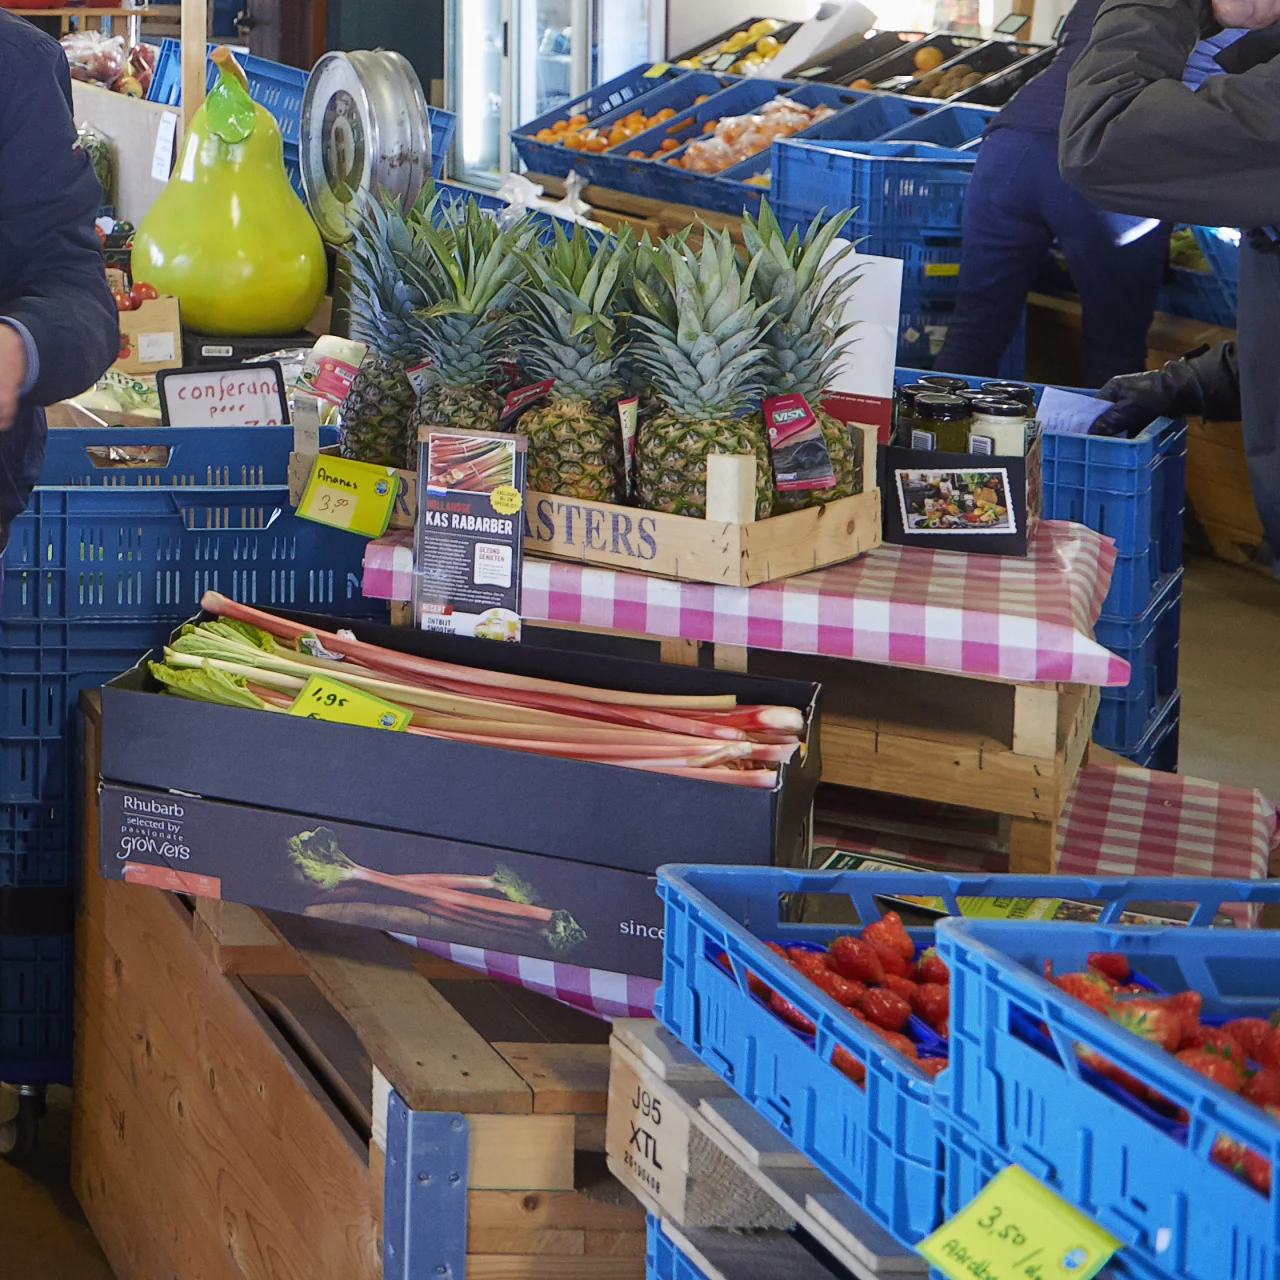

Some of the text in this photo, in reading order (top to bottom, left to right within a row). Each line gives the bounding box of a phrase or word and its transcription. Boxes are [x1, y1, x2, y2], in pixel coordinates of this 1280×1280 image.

[773, 407, 807, 422] VISA
[317, 467, 358, 490] Ananas
[425, 512, 513, 536] KAS RABARBER
[123, 795, 184, 818] Rhubarb
[121, 825, 184, 842] passionate
[126, 816, 181, 834] selected by
[116, 836, 191, 860] growers
[619, 920, 666, 940] since
[631, 1085, 662, 1125] J95
[629, 1119, 663, 1170] XTL
[976, 1206, 1026, 1247] 3,50
